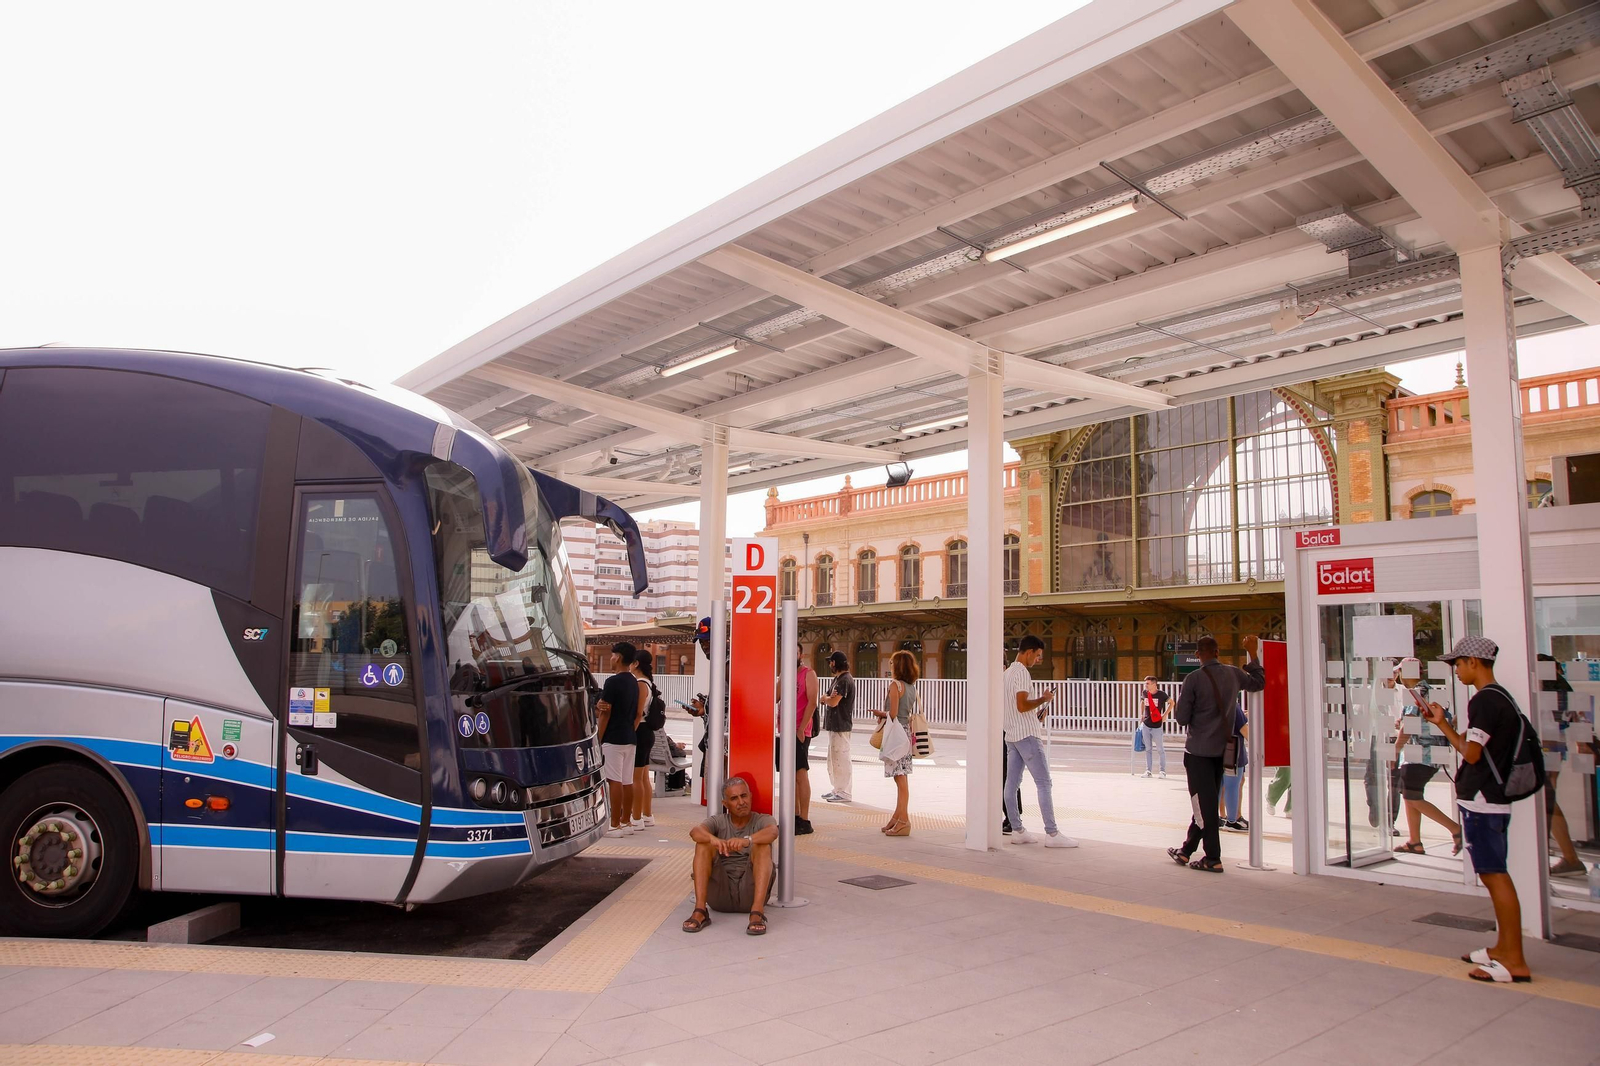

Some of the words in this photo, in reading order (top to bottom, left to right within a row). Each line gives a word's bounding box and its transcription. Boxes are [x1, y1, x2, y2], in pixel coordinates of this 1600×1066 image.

[1301, 531, 1335, 545] balat
[746, 543, 765, 571] D
[1320, 564, 1371, 585] balat
[735, 585, 773, 614] 22
[243, 628, 268, 640] SC7
[570, 815, 584, 833] 3197
[467, 829, 493, 841] 3371
